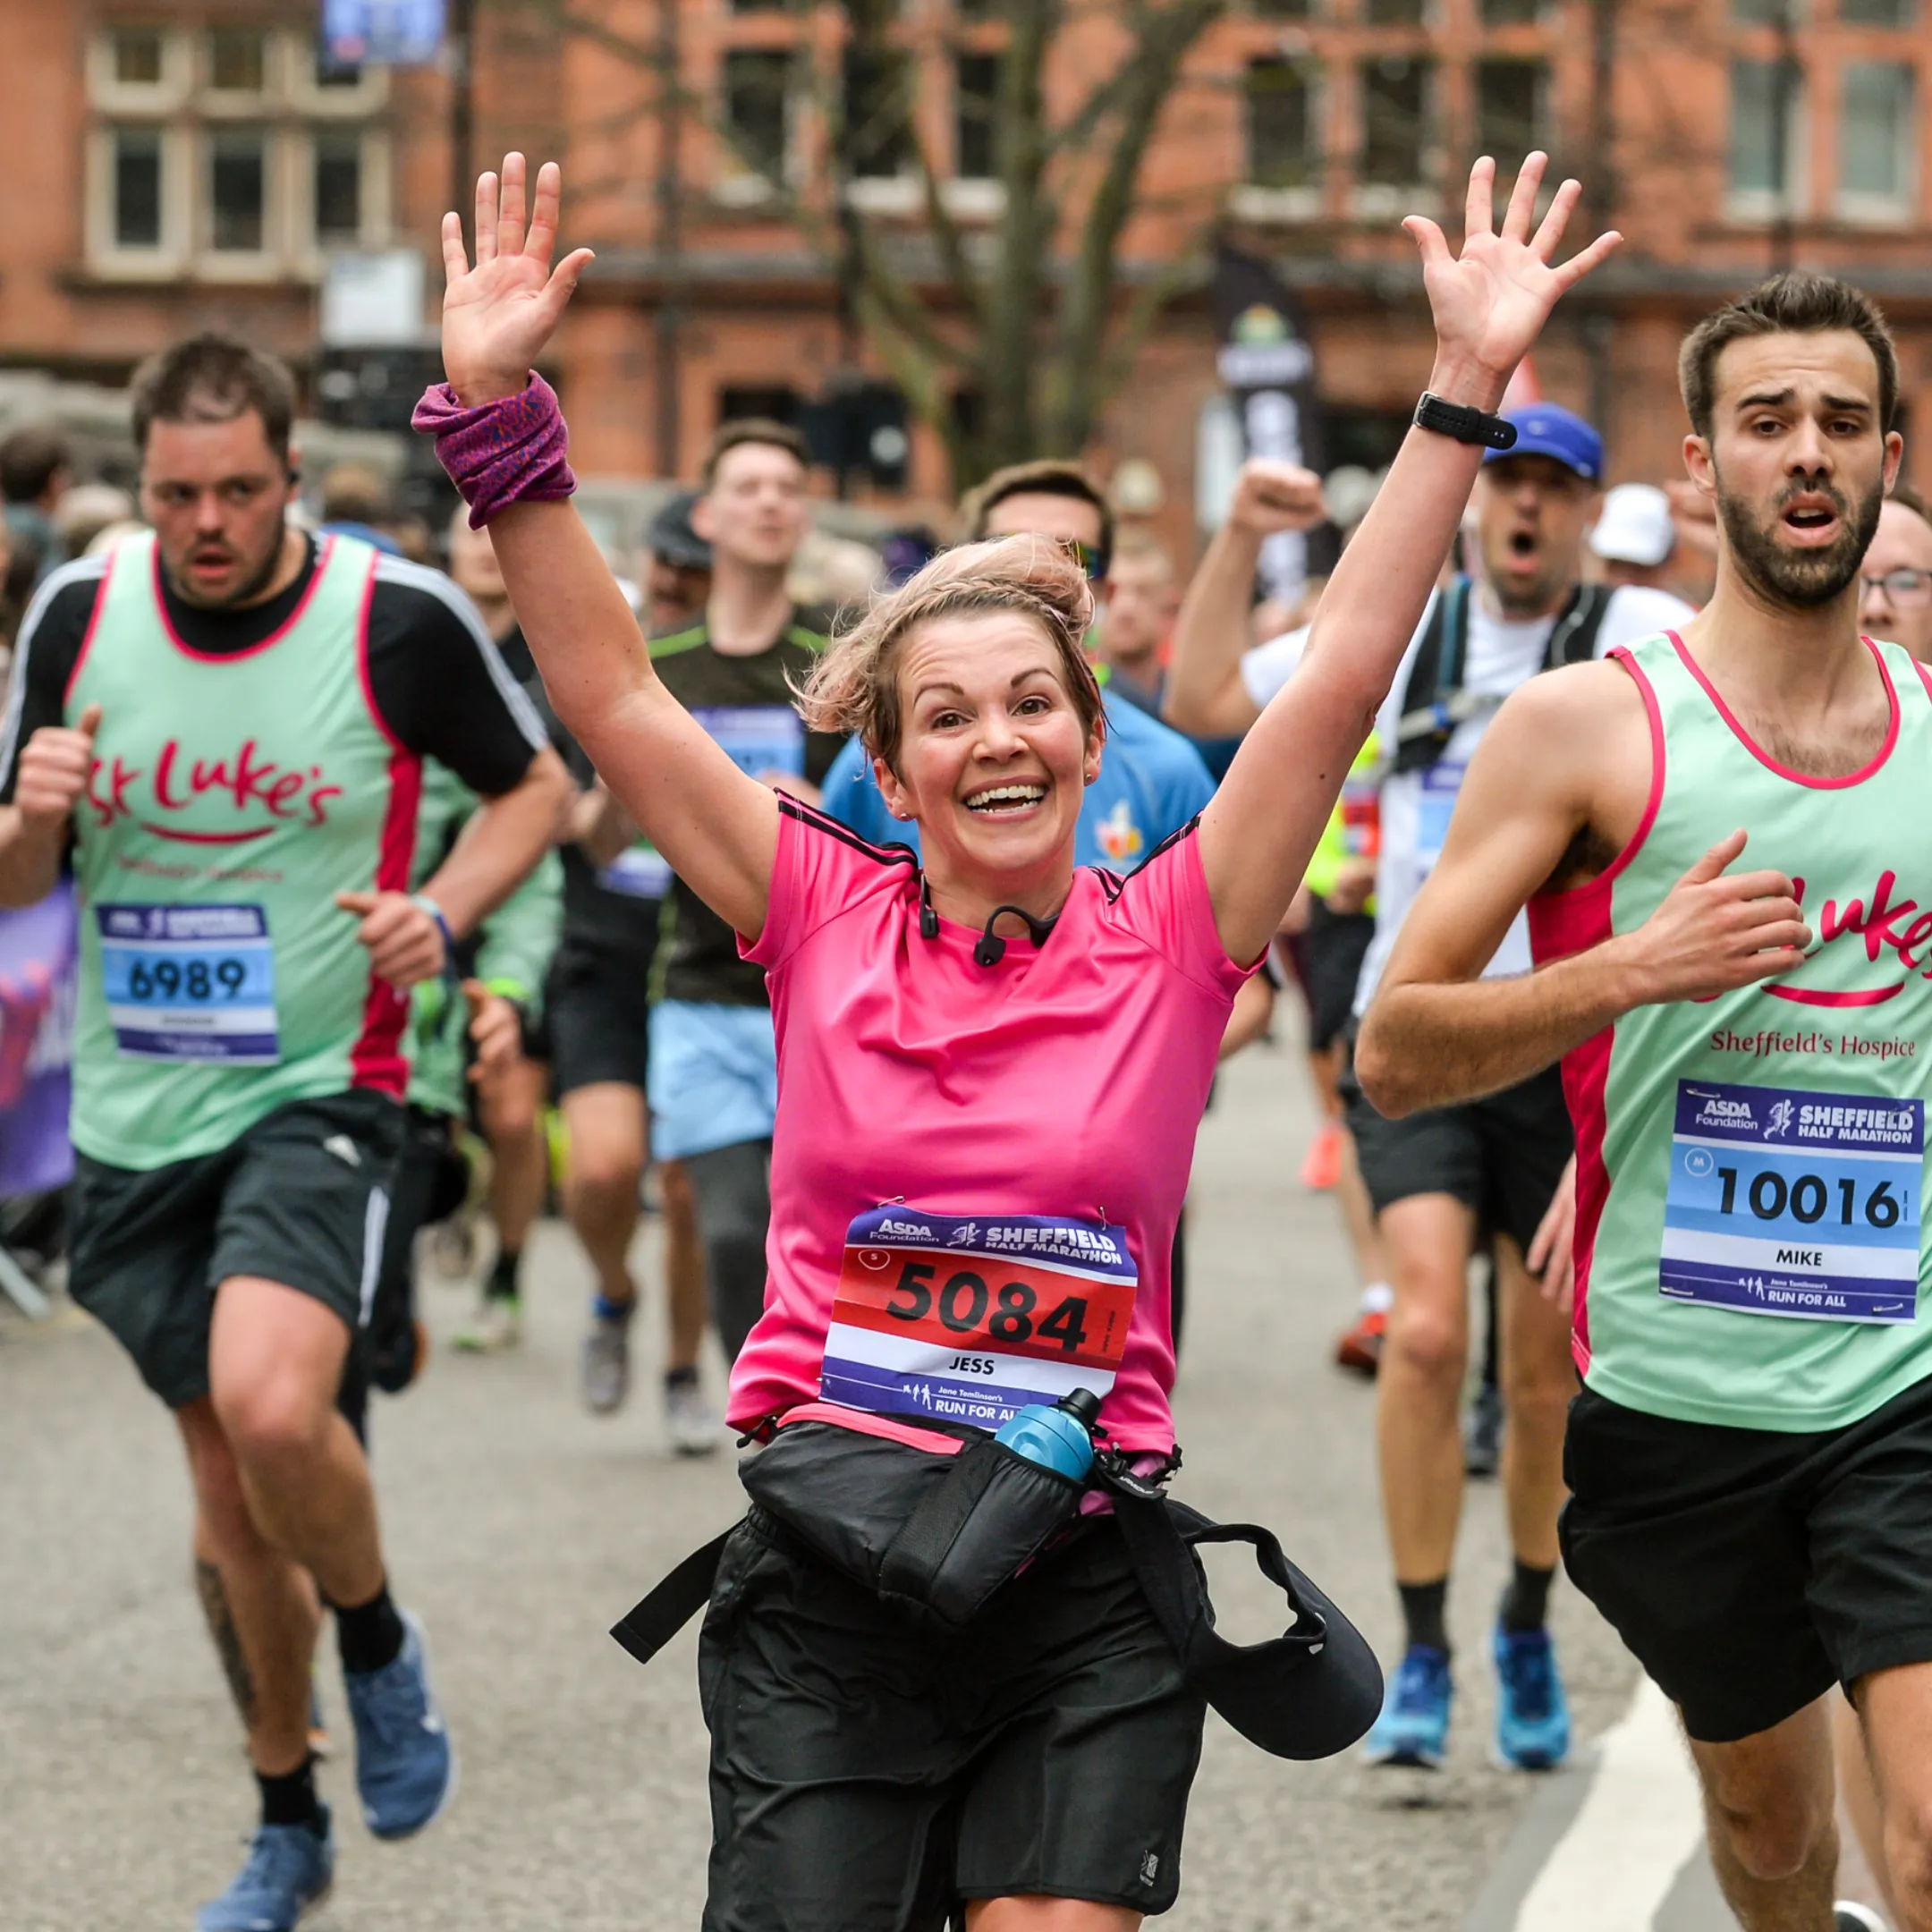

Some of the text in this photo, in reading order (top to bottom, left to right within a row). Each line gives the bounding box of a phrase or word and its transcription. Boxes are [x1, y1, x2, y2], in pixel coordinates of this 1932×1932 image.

[153, 737, 343, 829] Luke's
[1792, 869, 1932, 980] uke
[130, 959, 246, 1000] 6989
[1710, 1030, 1915, 1061] Sheffield's Hospice
[1704, 1099, 1752, 1119] ASDA
[1799, 1105, 1914, 1131] SHEFFIELD
[1695, 1114, 1758, 1131] Foundation
[1798, 1125, 1912, 1144] HALF MARATHON
[1717, 1167, 1900, 1229] 10016
[869, 1231, 940, 1243] Foundation
[878, 1218, 933, 1238] ASDA
[986, 1226, 1117, 1252] SHEFFIELD
[985, 1241, 1123, 1266] HALF MARATHON
[1775, 1249, 1823, 1267] MIKE
[885, 1262, 1089, 1352] 5084
[1767, 1290, 1847, 1309] RUN FOR ALL
[948, 1356, 996, 1376] JESS
[938, 1385, 1004, 1403] Jane Tomlinson's
[935, 1399, 966, 1416] RUN
[968, 1403, 996, 1420] FOR
